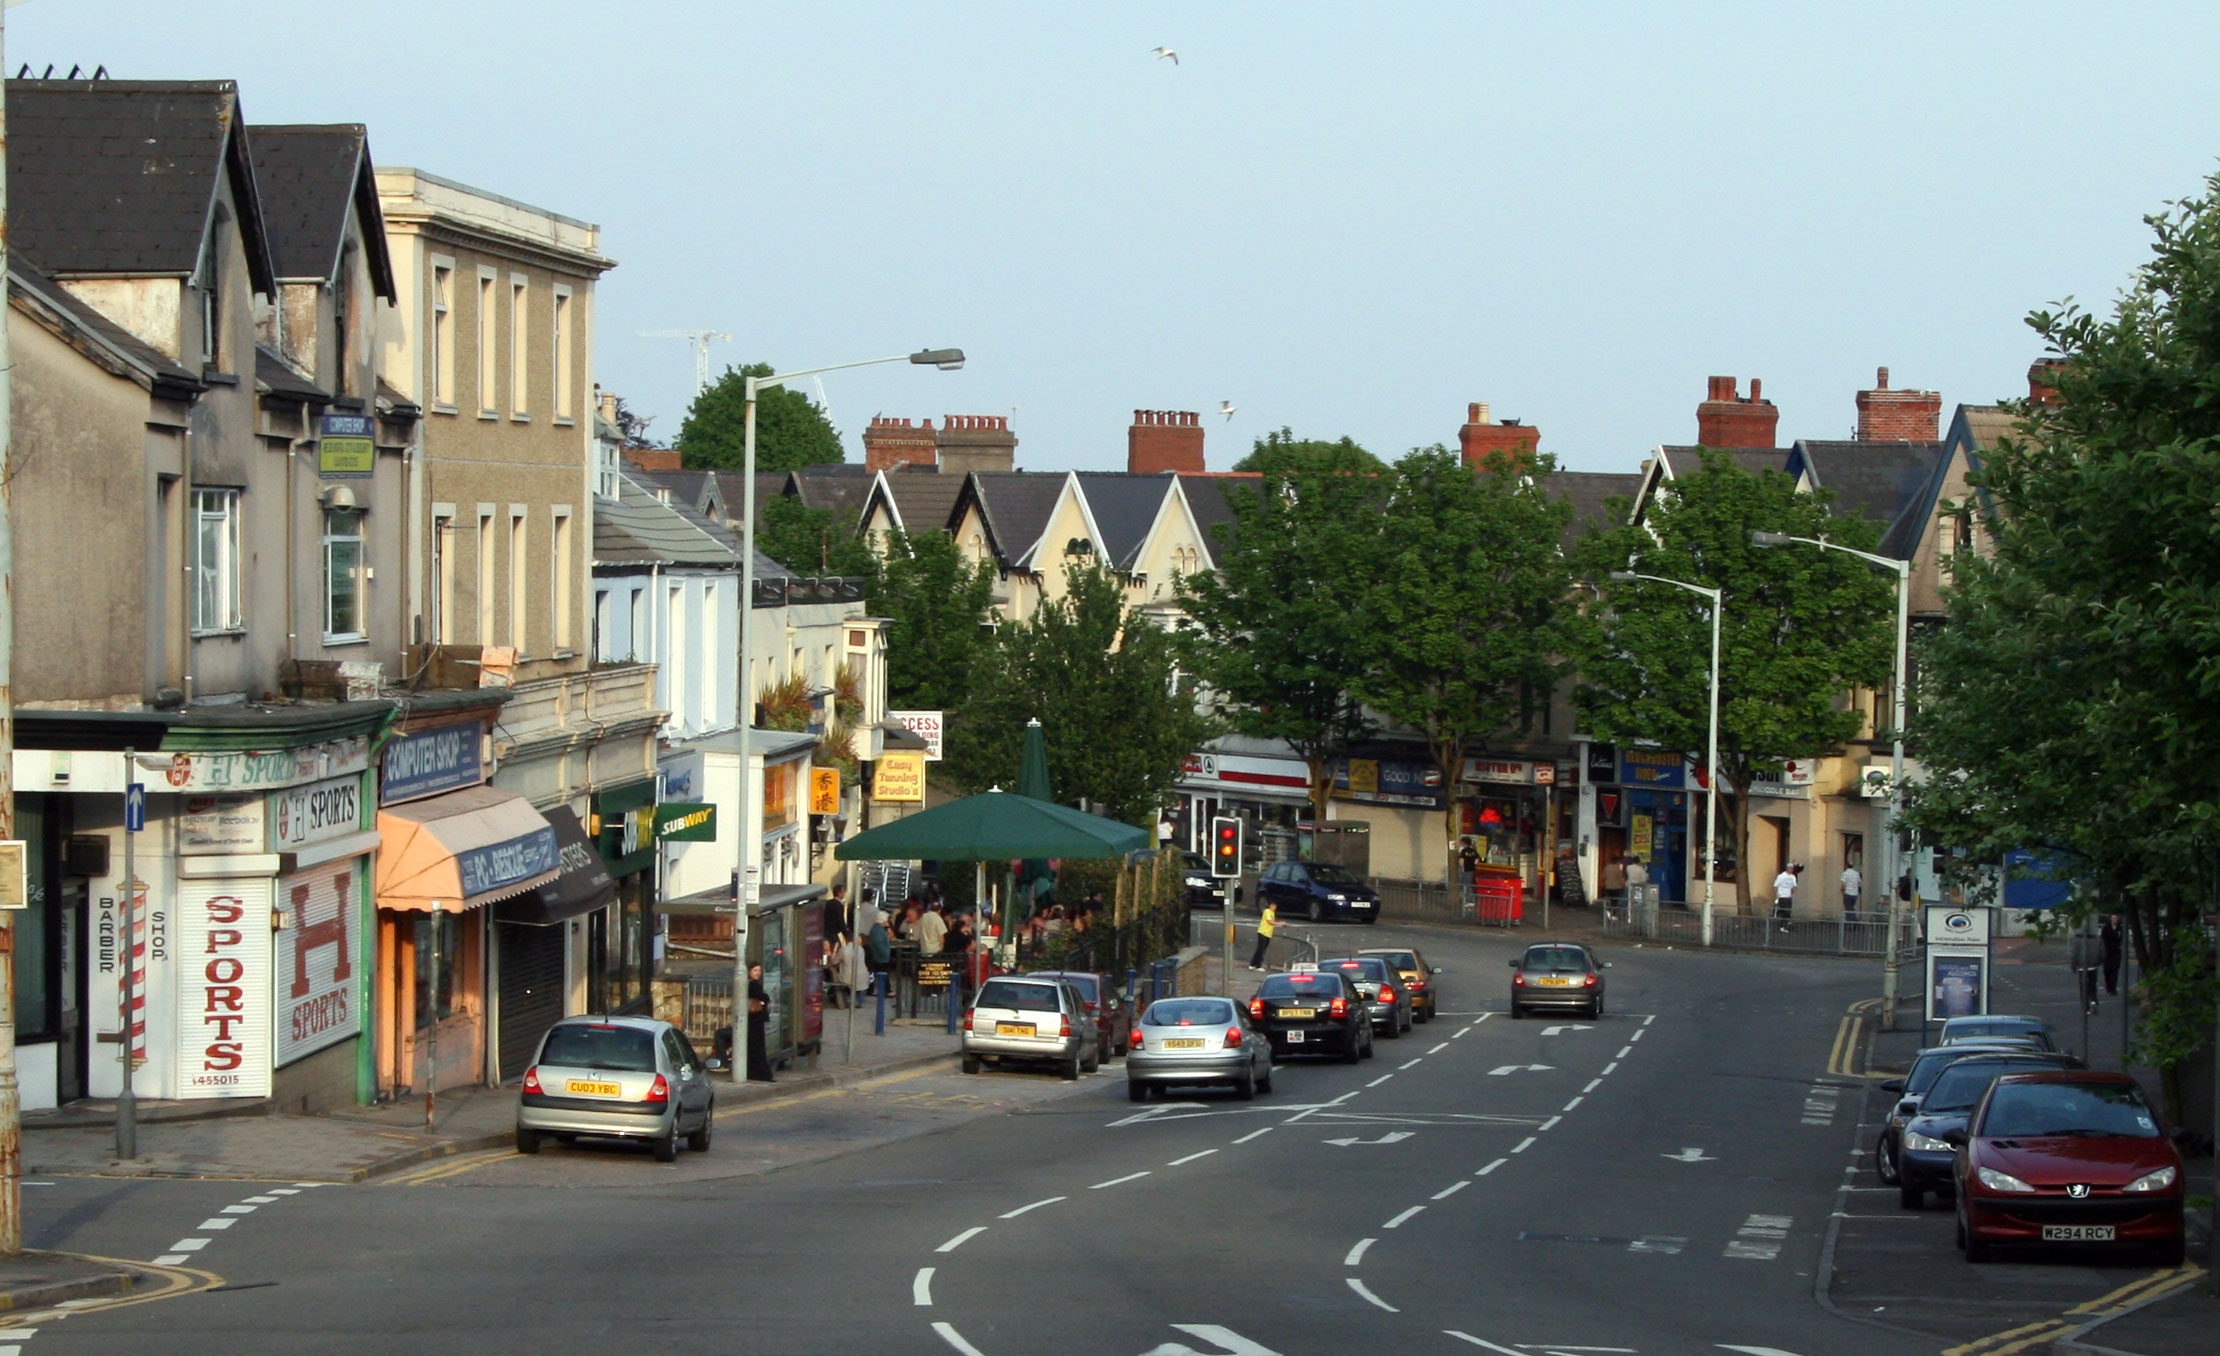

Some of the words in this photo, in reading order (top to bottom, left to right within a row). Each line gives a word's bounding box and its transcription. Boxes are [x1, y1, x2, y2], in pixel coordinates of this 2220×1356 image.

[388, 735, 436, 782] COMPUTER
[436, 731, 461, 771] SHOP
[879, 773, 919, 785] Tanning
[887, 760, 912, 771] Easy
[1383, 769, 1410, 783] GOOD
[311, 784, 355, 829] SPORTS
[878, 786, 919, 796] Studio's
[661, 808, 713, 835] SUBWAY
[99, 897, 114, 974] BARBER
[151, 911, 166, 961] SHOP
[290, 870, 352, 999] H
[205, 895, 244, 1072] SPORTS
[291, 987, 348, 1042] SPORTS
[2044, 1227, 2082, 1240] W294
[2085, 1227, 2114, 1239] RCY
